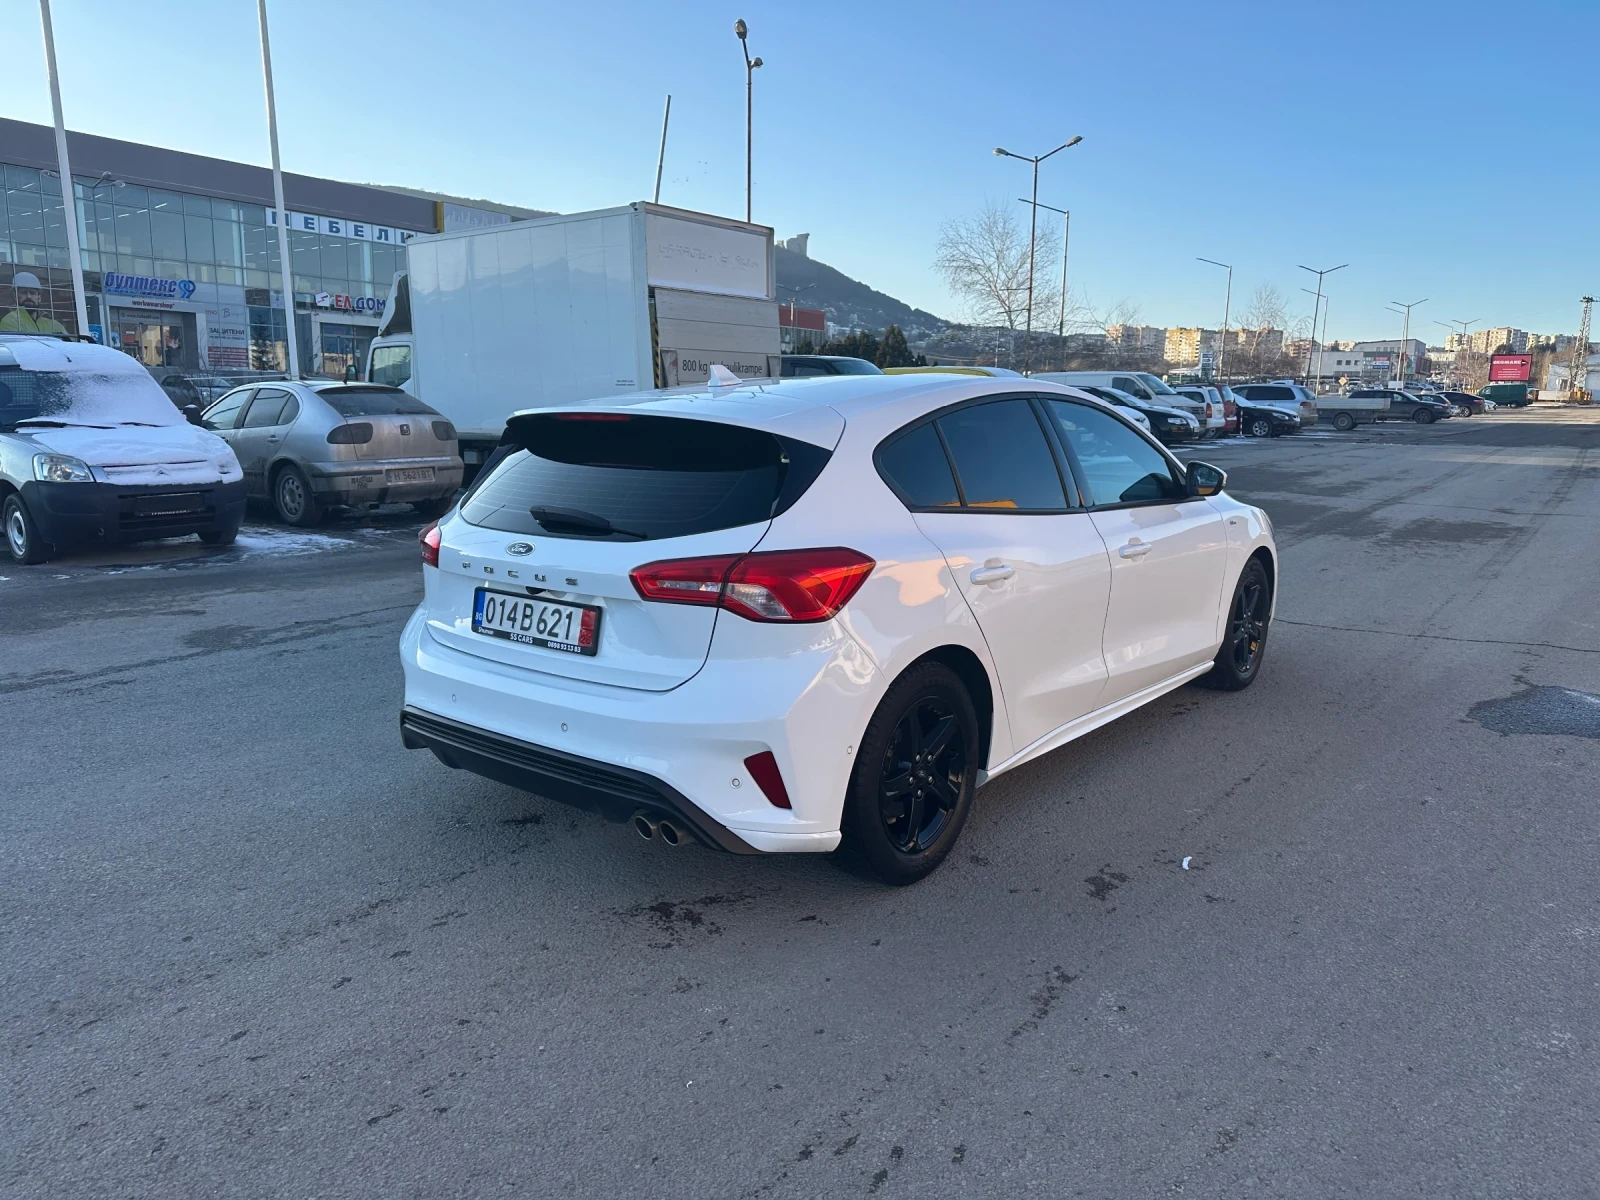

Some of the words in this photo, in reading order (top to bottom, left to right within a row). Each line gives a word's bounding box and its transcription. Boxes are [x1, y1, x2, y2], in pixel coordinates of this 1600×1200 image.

[105, 271, 177, 293] бултекс
[682, 360, 696, 372] 800
[699, 360, 708, 375] kg
[710, 361, 762, 376] raulikrampe
[462, 561, 578, 586] FOCUS
[518, 634, 534, 644] CARS
